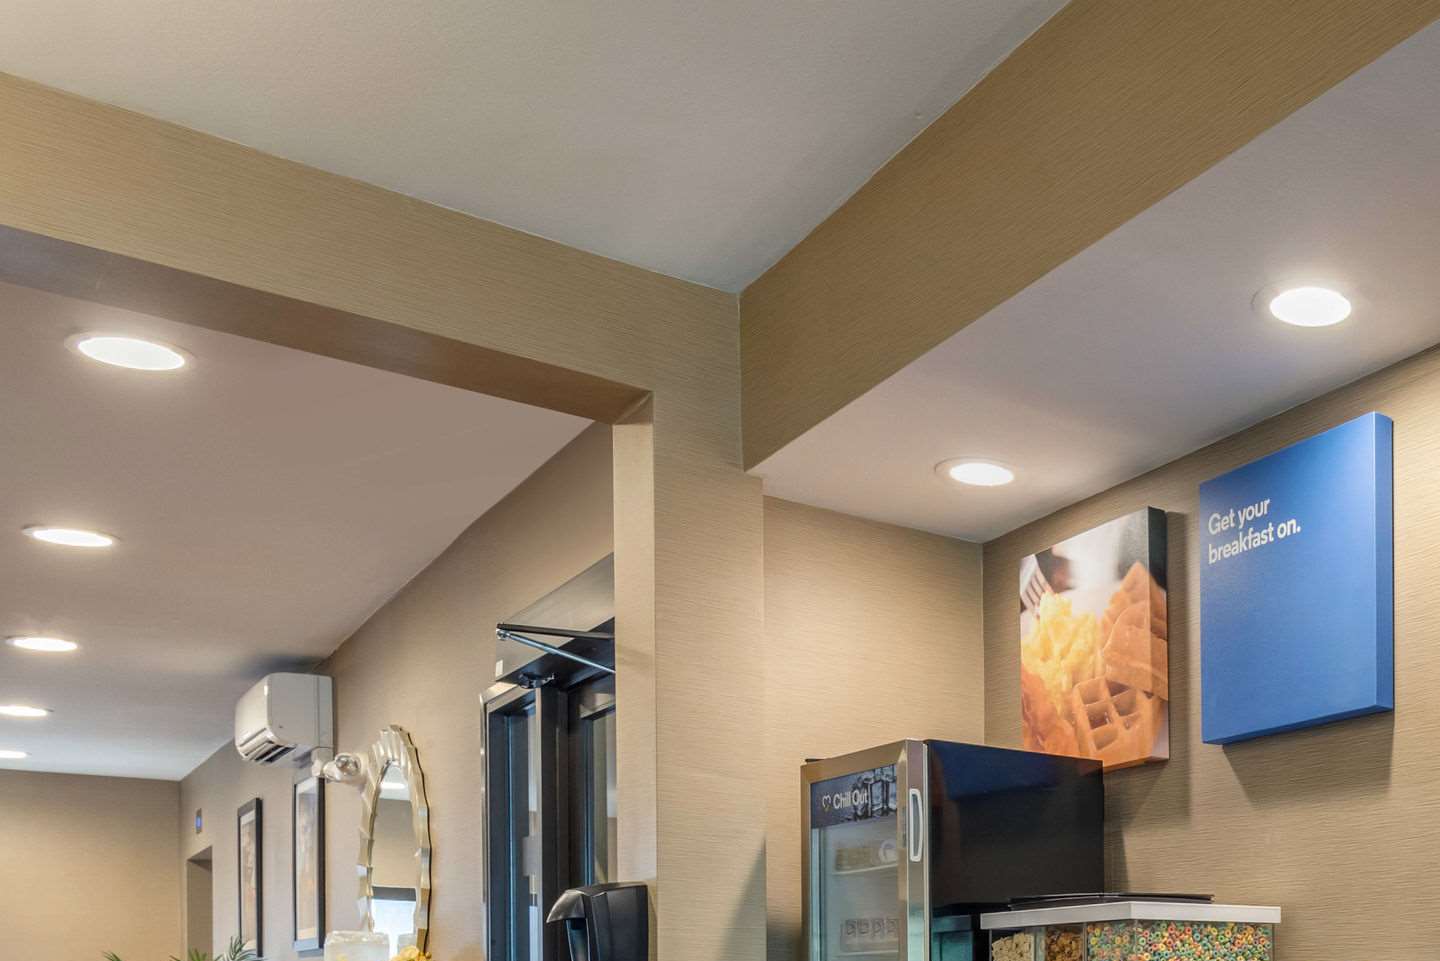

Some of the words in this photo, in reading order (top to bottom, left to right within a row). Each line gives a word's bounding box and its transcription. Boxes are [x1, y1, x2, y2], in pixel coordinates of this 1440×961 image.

[1208, 509, 1236, 535] Get
[1237, 498, 1271, 529] your
[1208, 523, 1275, 565] breakfast
[1277, 518, 1302, 539] on.
[833, 791, 851, 809] Chill
[852, 789, 868, 806] Out
